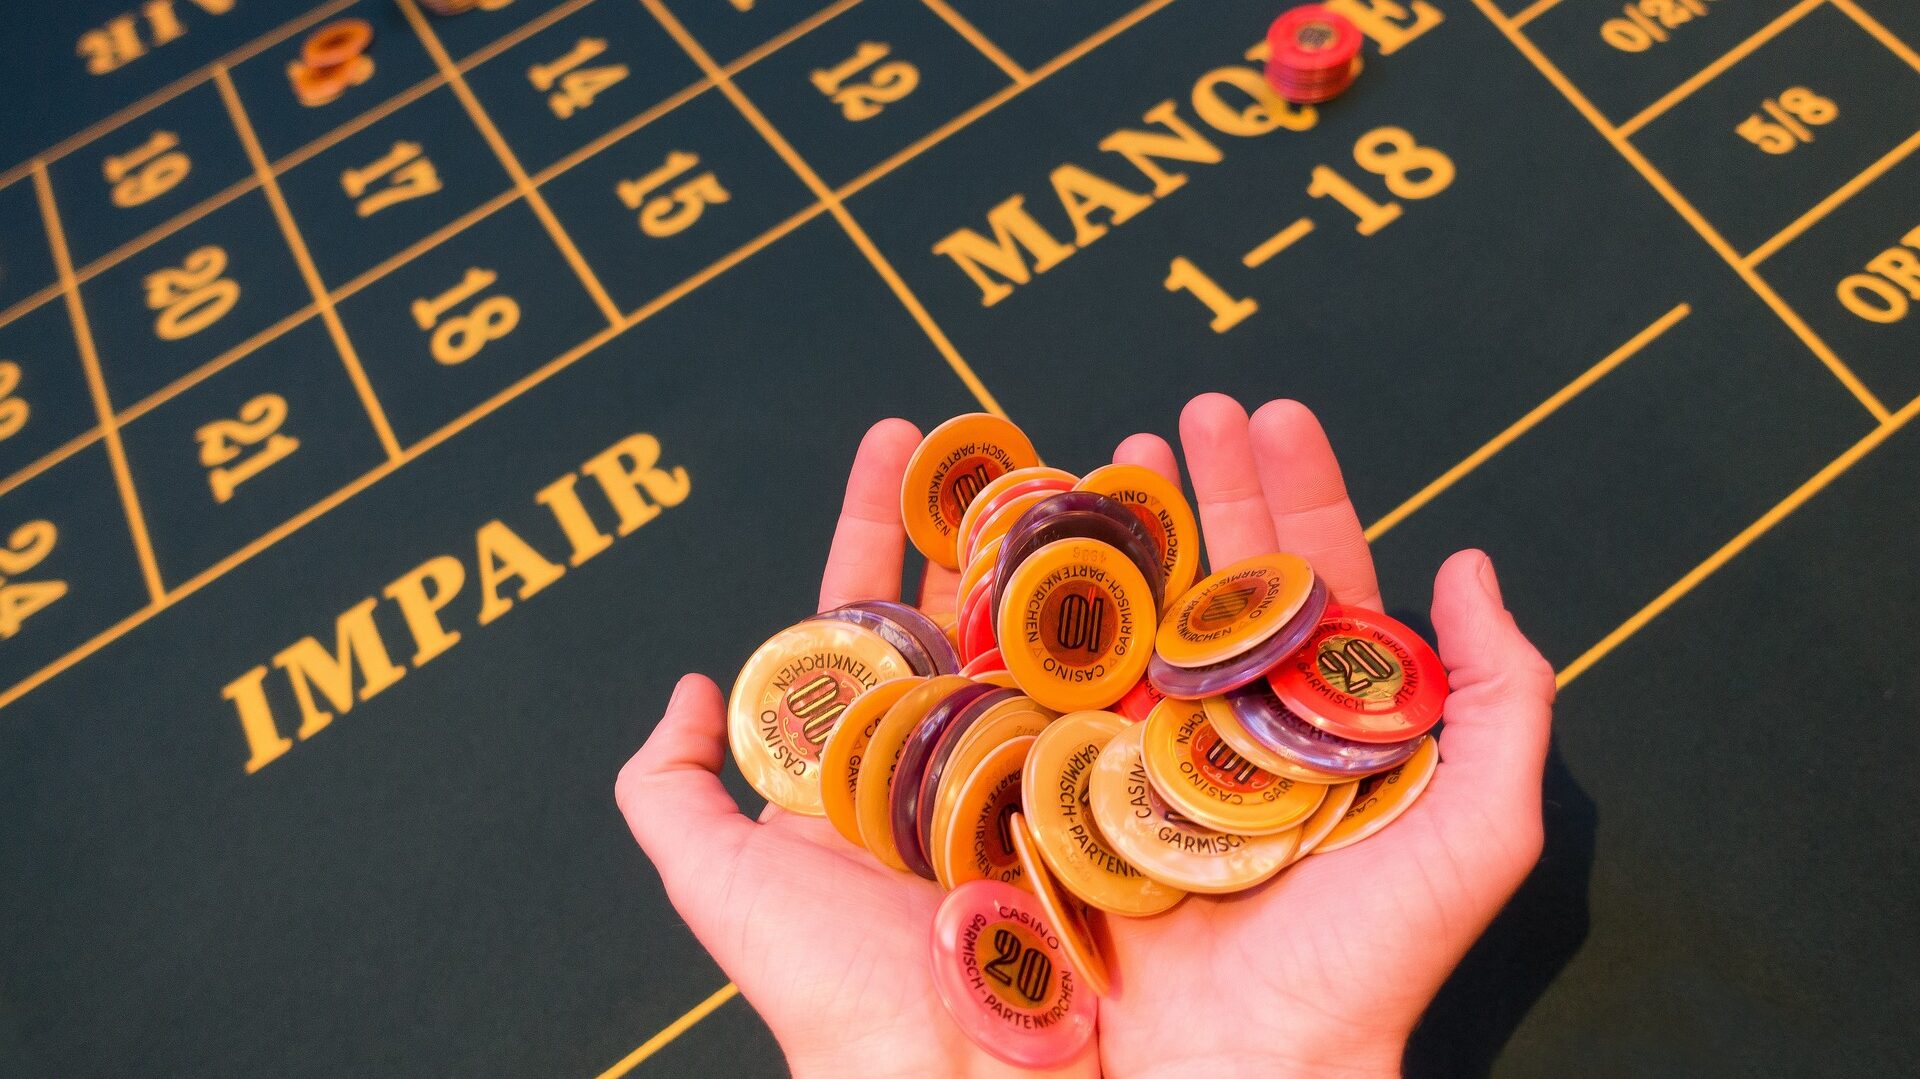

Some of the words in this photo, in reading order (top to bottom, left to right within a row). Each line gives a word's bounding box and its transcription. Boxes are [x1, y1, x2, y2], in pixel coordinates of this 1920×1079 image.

[527, 37, 630, 119] 14
[810, 41, 920, 122] 12
[933, 0, 1445, 308] MANQE
[1735, 86, 1839, 155] 5/8
[104, 131, 191, 207] 19
[342, 141, 441, 216] 17
[616, 151, 730, 237] 15
[144, 245, 240, 340] 20
[411, 267, 520, 364] 18
[196, 394, 299, 503] 21
[221, 432, 691, 774] IMPAIR
[1057, 592, 1105, 654] 10
[1249, 576, 1280, 619] CASINO
[1043, 658, 1105, 682] CASINO
[1318, 639, 1394, 694] 20
[760, 709, 807, 777] CASINO
[1128, 754, 1152, 819] CASIN
[1180, 761, 1244, 806] CASINO
[999, 905, 1060, 950] CASINO
[984, 928, 1052, 1002] 20
